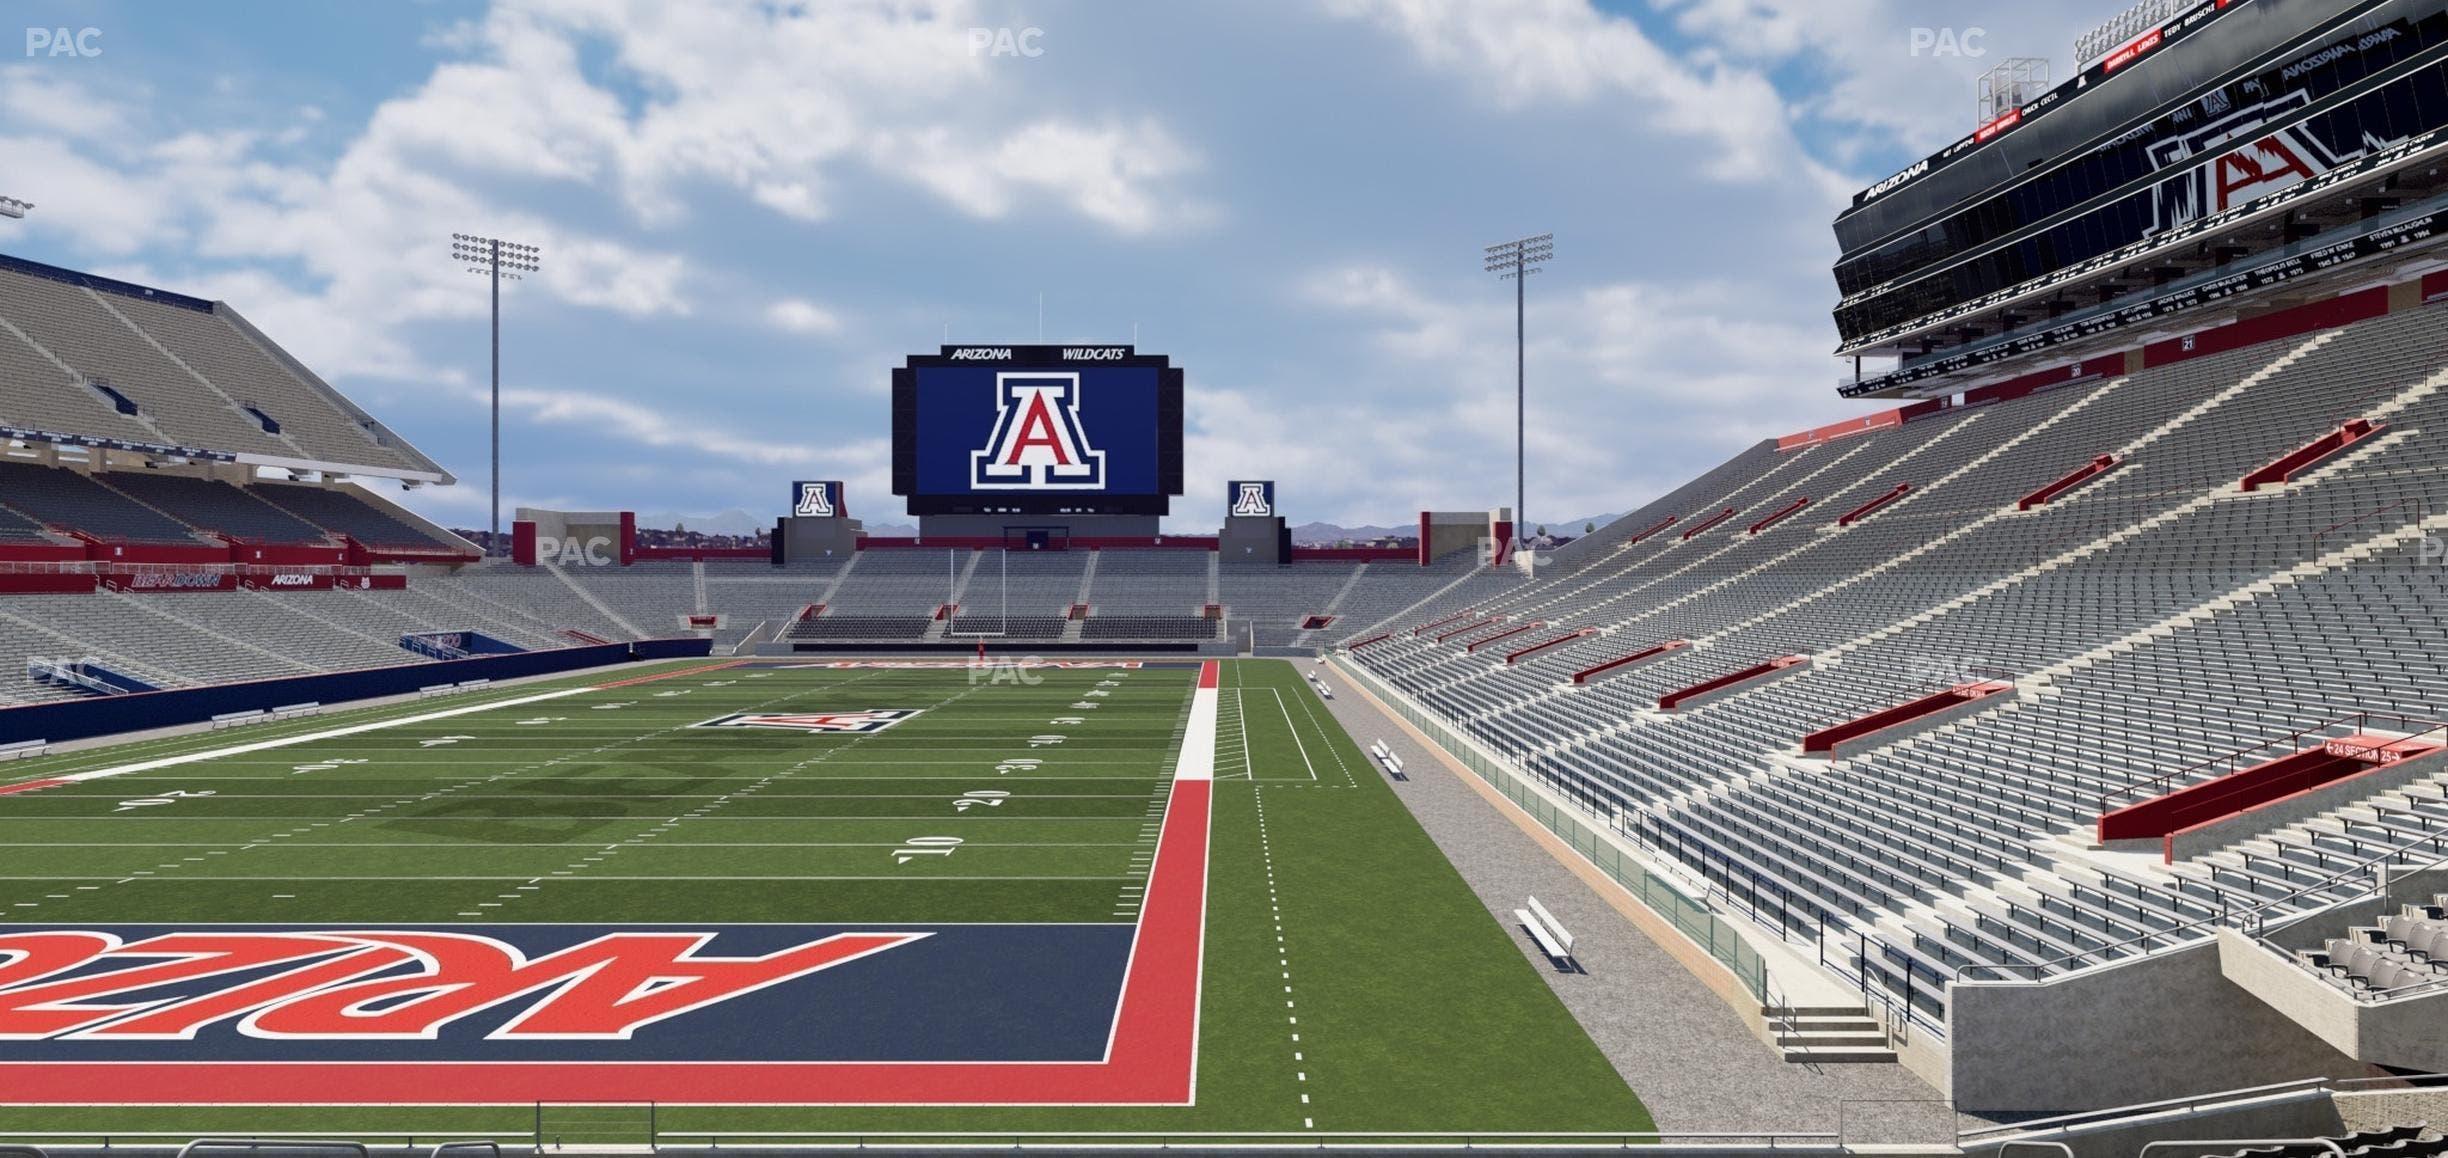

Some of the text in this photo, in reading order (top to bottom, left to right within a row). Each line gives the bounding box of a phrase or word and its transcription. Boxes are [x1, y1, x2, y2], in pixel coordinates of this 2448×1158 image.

[2164, 3, 2216, 38] TEDY BRUSCHI
[1863, 160, 1929, 202] ARIZONA
[2369, 230, 2392, 242] STEVEN
[951, 348, 1126, 360] ARIZONA WILDCATS
[970, 372, 1106, 490] A
[796, 483, 834, 517] A
[1233, 483, 1271, 517] A
[271, 574, 313, 586] ARIZONA
[2334, 745, 2392, 762] 24 SECTION 25
[891, 836, 965, 857] 10
